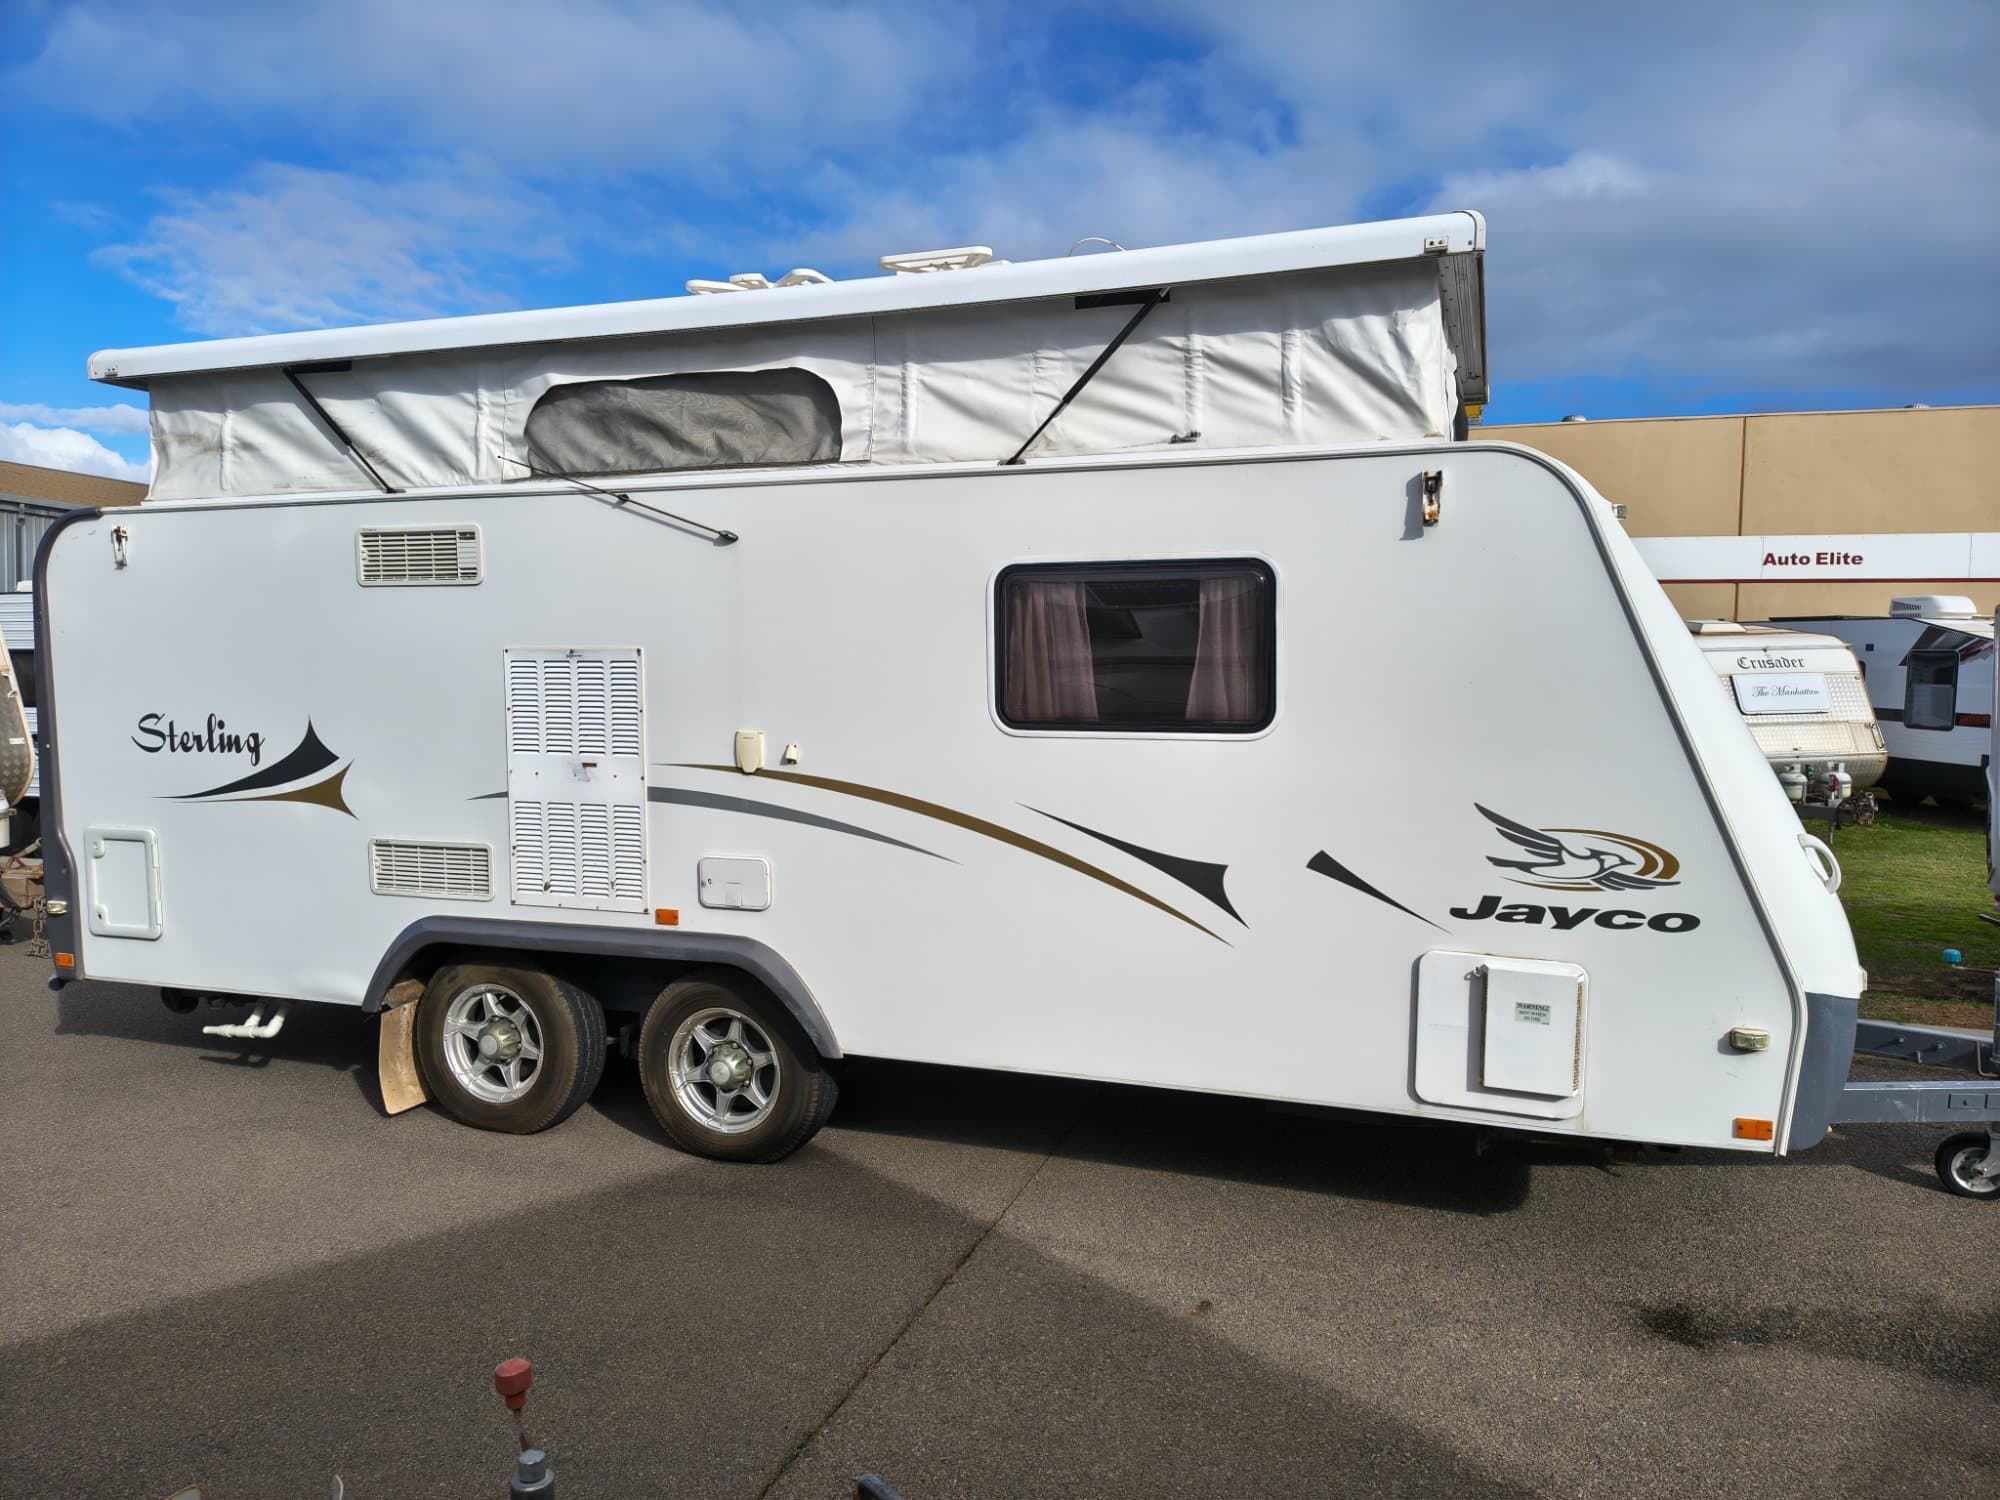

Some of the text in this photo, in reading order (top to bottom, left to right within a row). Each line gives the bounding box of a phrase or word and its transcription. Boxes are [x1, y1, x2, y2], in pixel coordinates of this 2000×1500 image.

[1762, 552, 1864, 566] Auto Elite
[1737, 656, 1806, 670] Crusader
[1752, 686, 1770, 697] The
[131, 712, 266, 767] Sterling
[1449, 895, 1701, 933] Jayco
